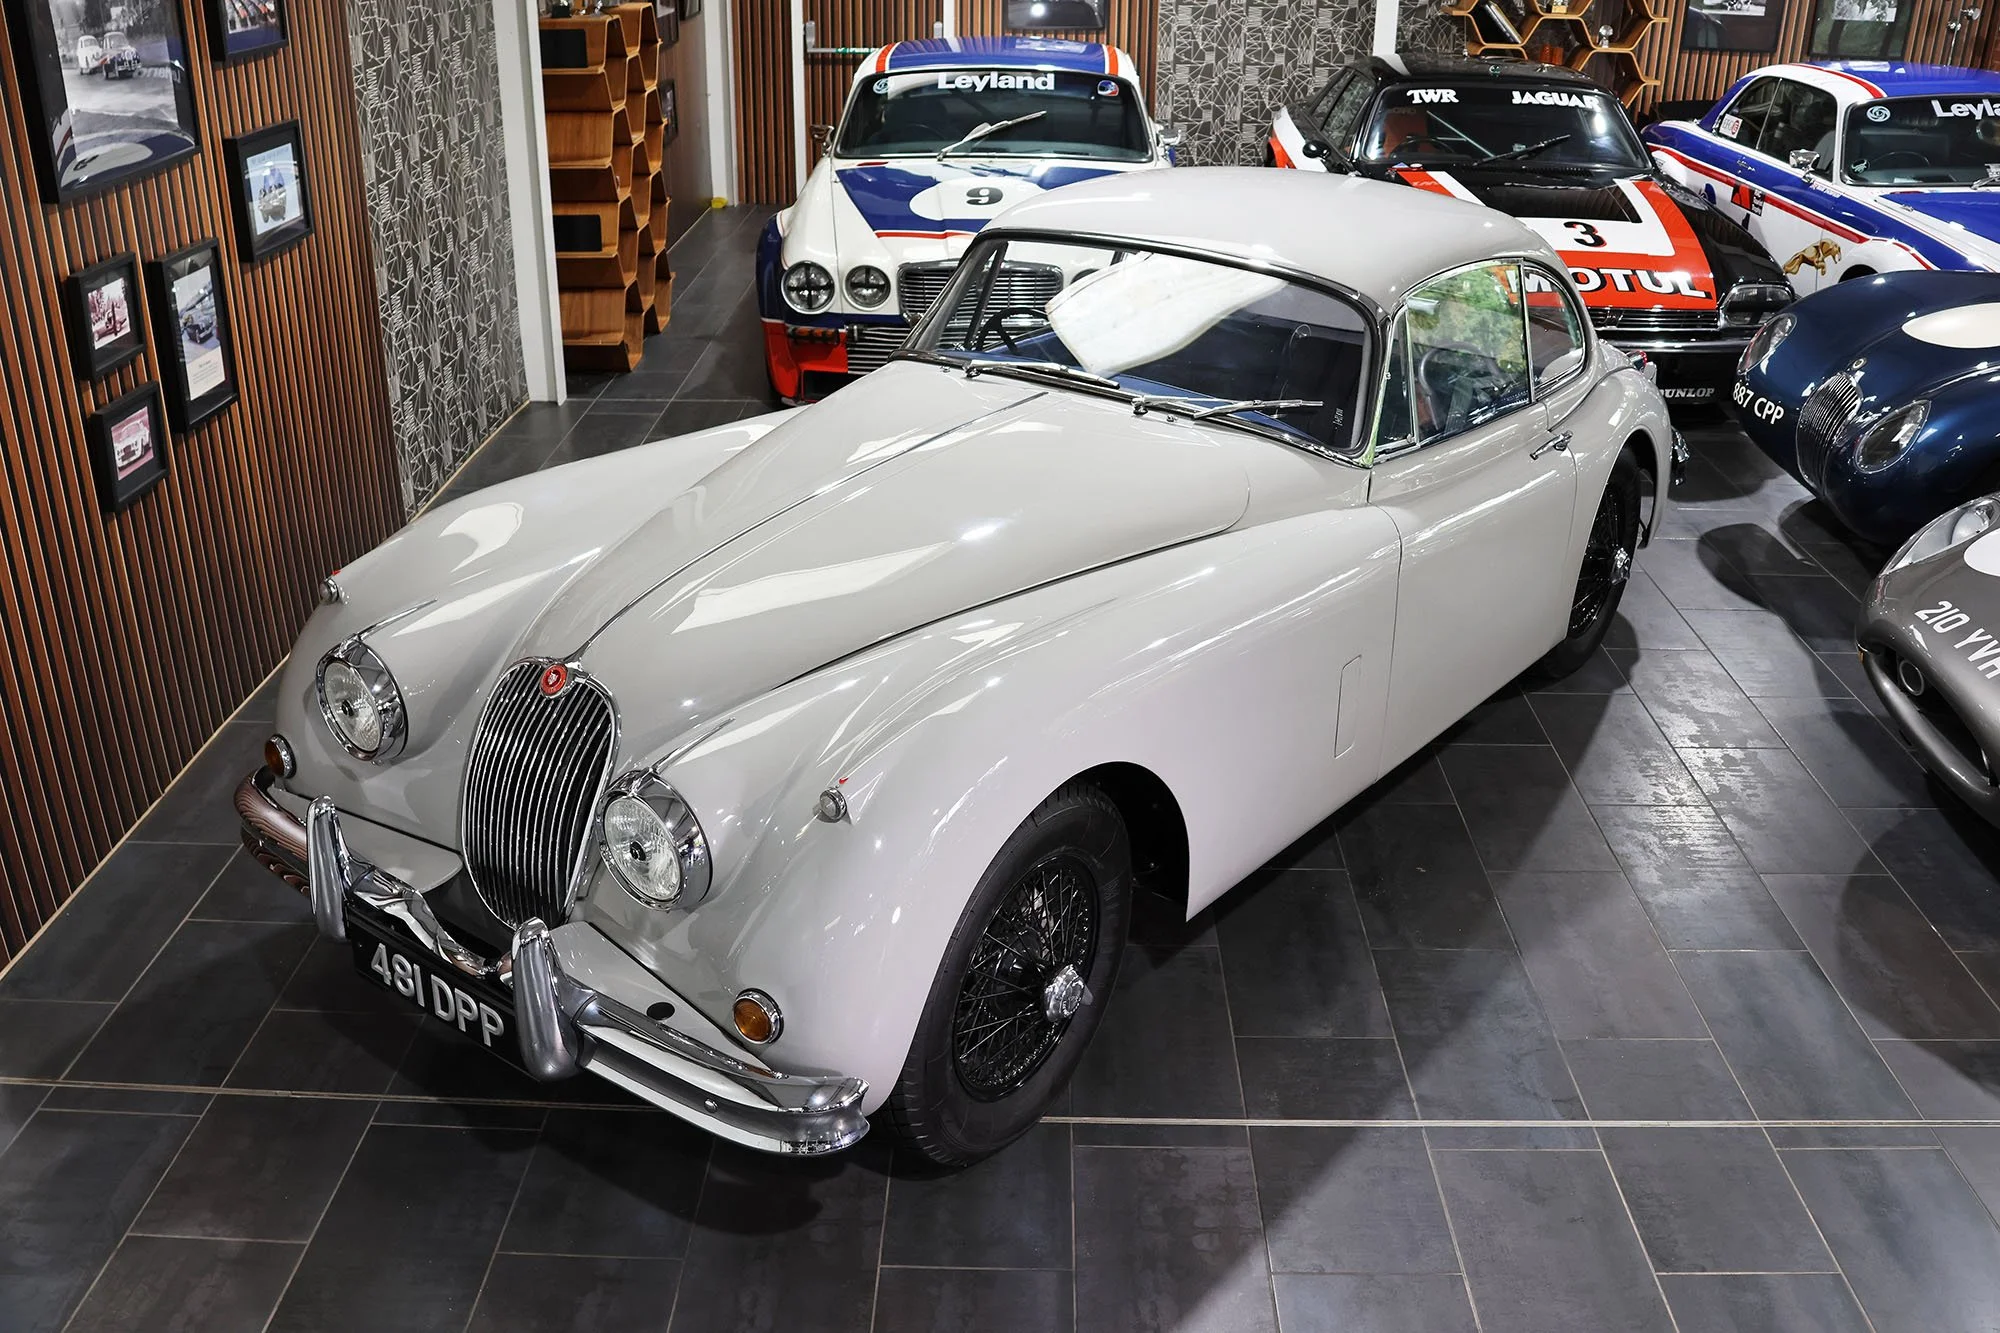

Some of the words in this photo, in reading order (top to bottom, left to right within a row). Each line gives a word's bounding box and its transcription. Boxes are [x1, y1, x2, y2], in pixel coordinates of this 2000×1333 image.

[937, 71, 1055, 91] Leyland
[1406, 88, 1459, 104] TWR
[1511, 90, 1602, 110] JAGUAR
[966, 186, 1004, 206] 9
[1563, 221, 1607, 248] 3
[1732, 381, 1755, 408] 887
[1753, 397, 1785, 425] CPP
[1914, 600, 1971, 633] 210
[370, 942, 425, 1008] 481
[430, 974, 505, 1047] DPP
